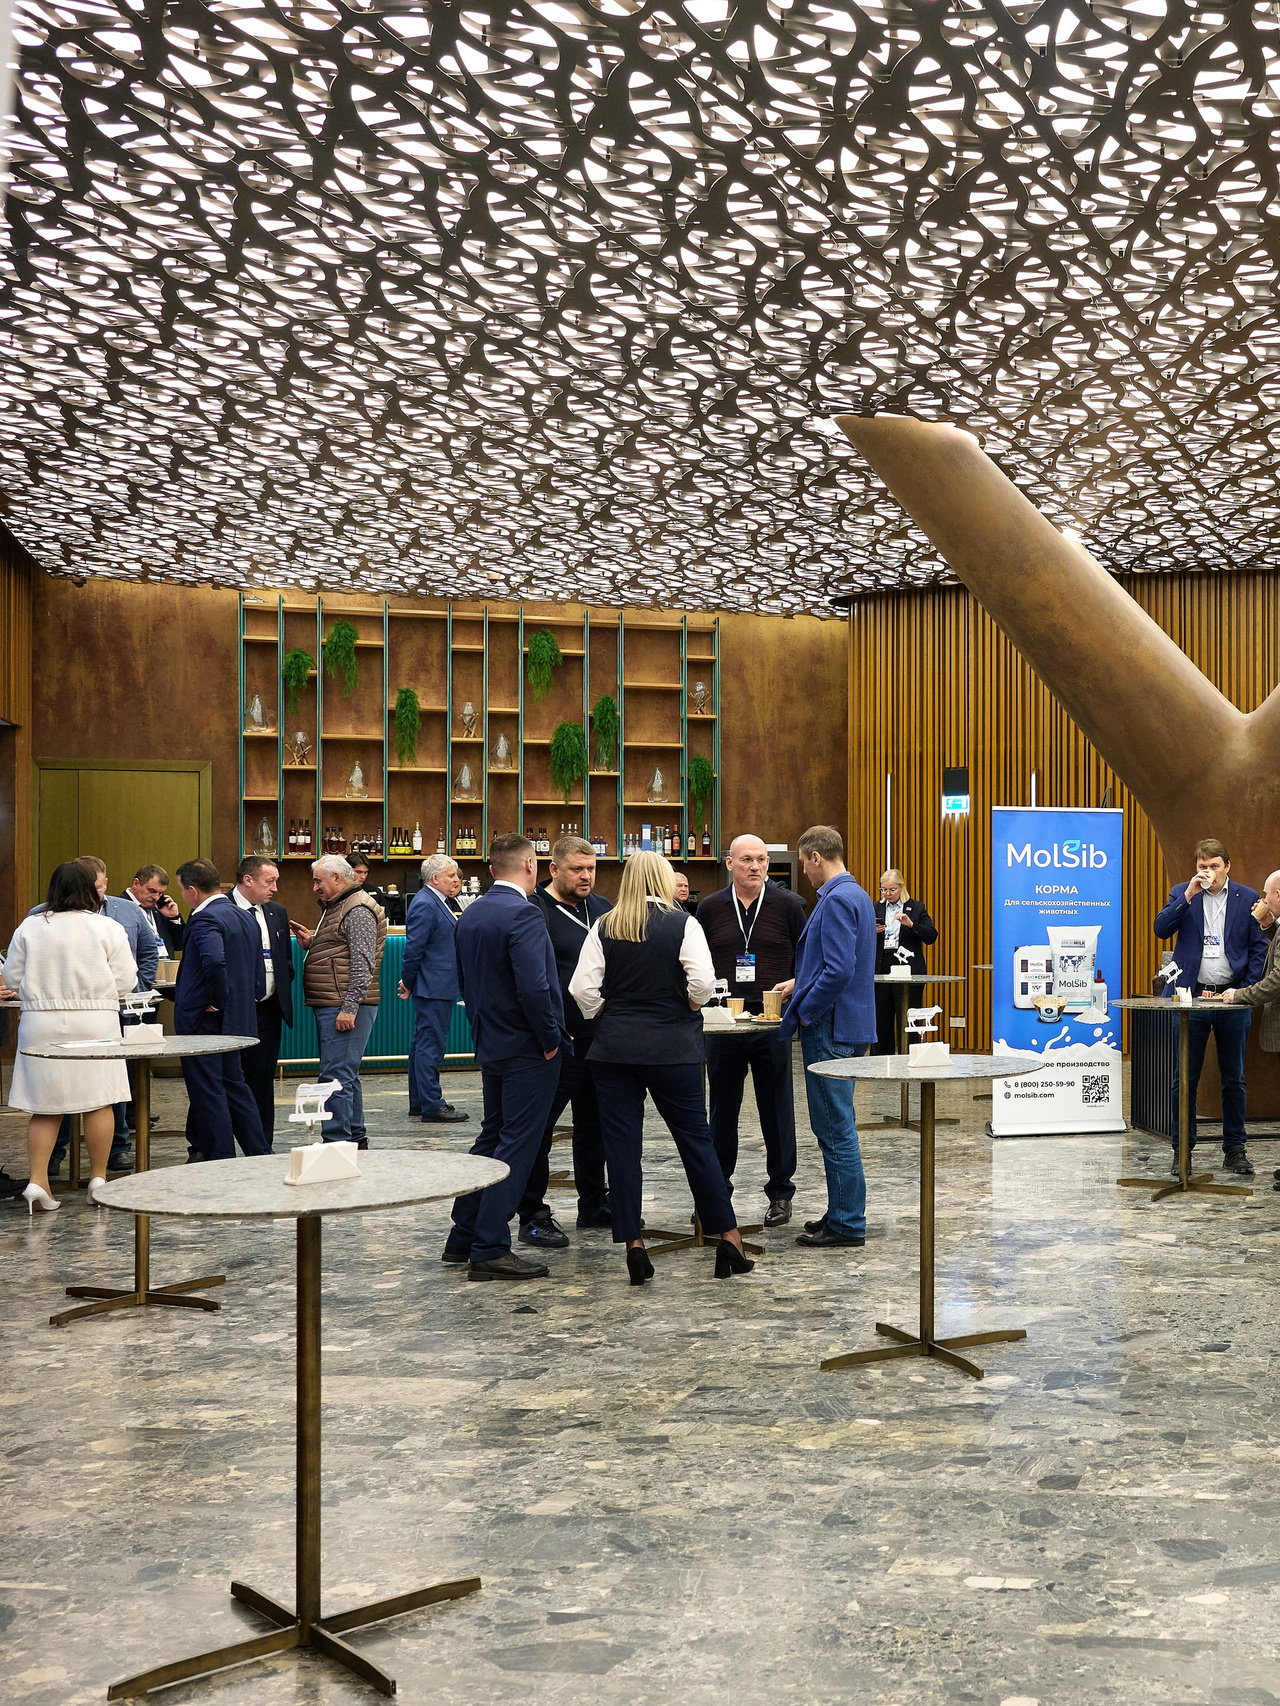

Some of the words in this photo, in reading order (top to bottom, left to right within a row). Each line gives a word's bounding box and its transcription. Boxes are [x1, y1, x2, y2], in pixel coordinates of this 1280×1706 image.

[1007, 839, 1107, 869] MolSib
[1035, 885, 1079, 894] КОРМА
[1021, 899, 1111, 907] сельскохозяйственных
[1059, 979, 1087, 988] MolSib
[1020, 1080, 1039, 1089] (800)
[1014, 1091, 1055, 1099] molsib.com
